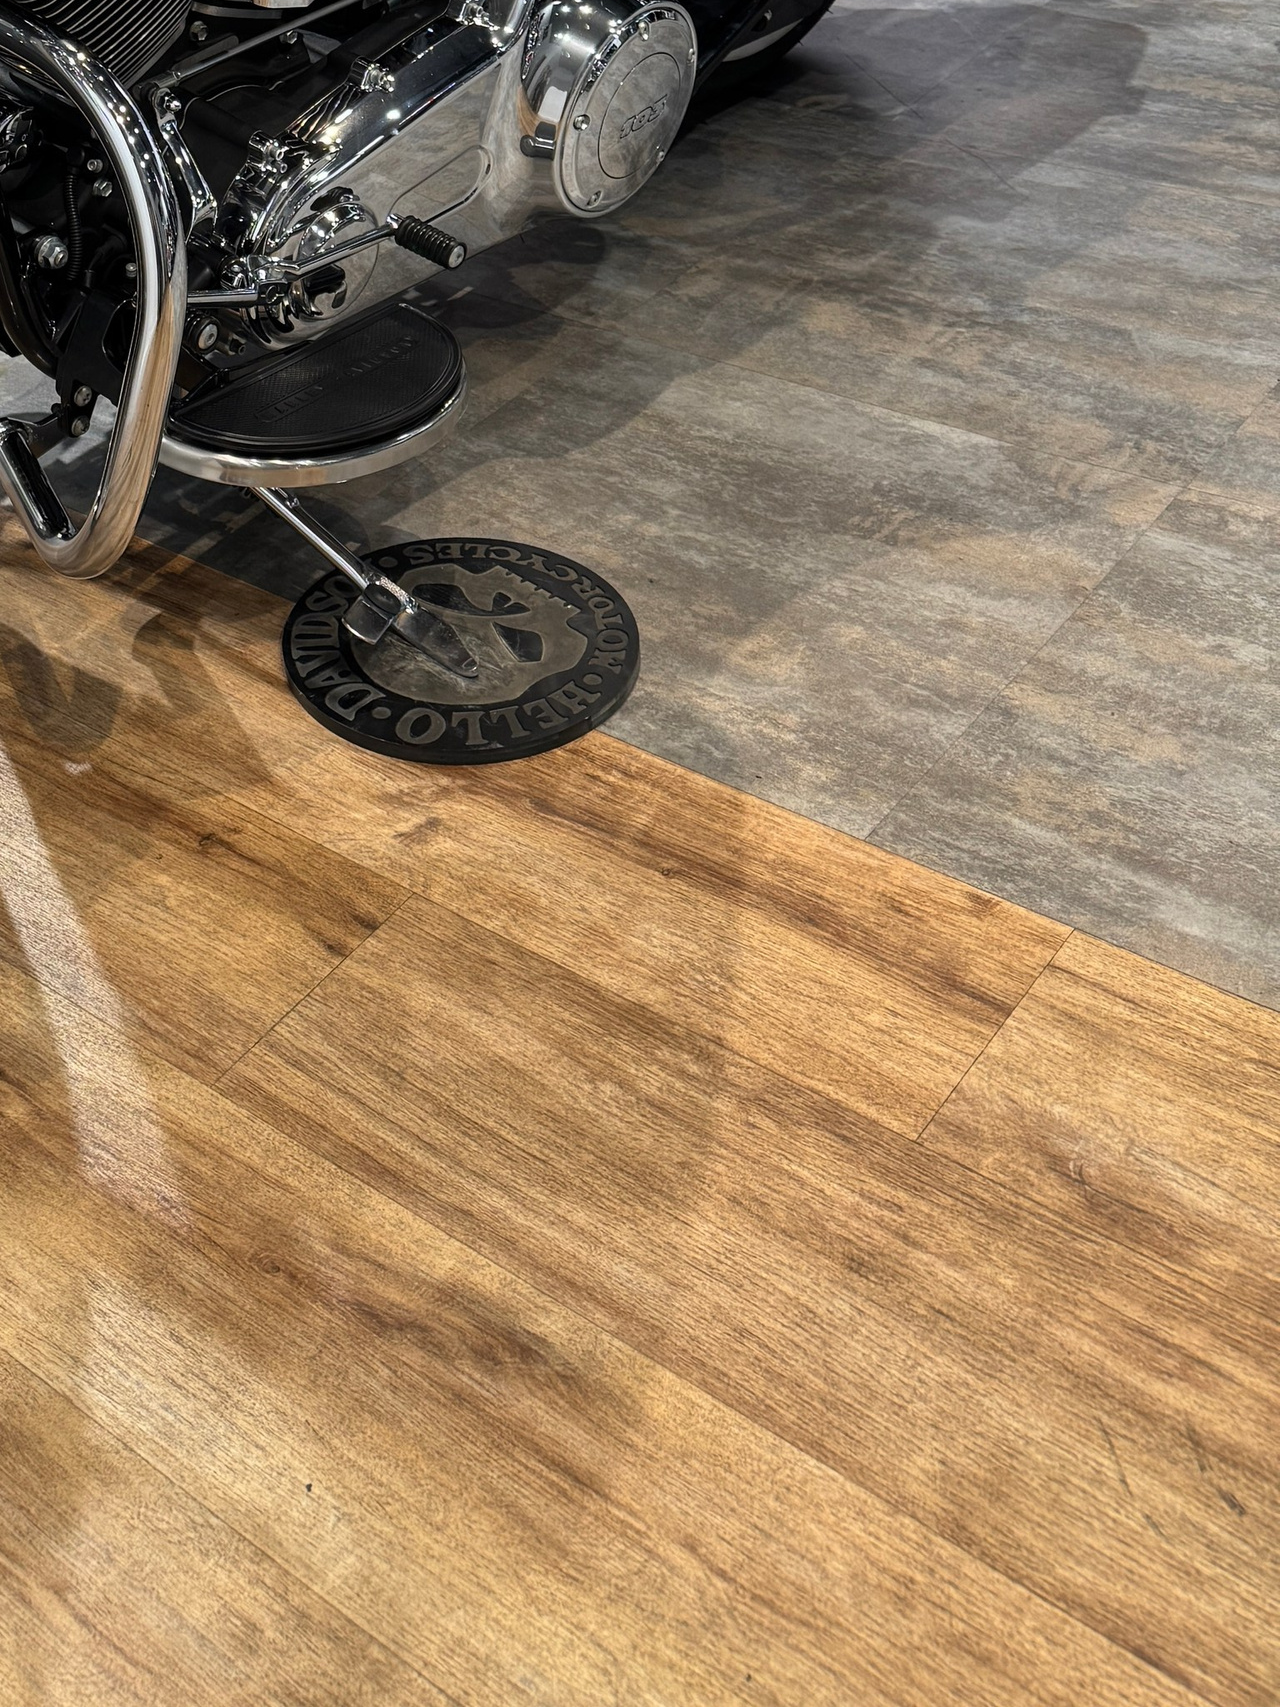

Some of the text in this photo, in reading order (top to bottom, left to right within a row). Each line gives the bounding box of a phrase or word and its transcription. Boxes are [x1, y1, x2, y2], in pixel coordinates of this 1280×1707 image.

[290, 542, 630, 746] HELLO DAVIDSO MOTORCYCLES
